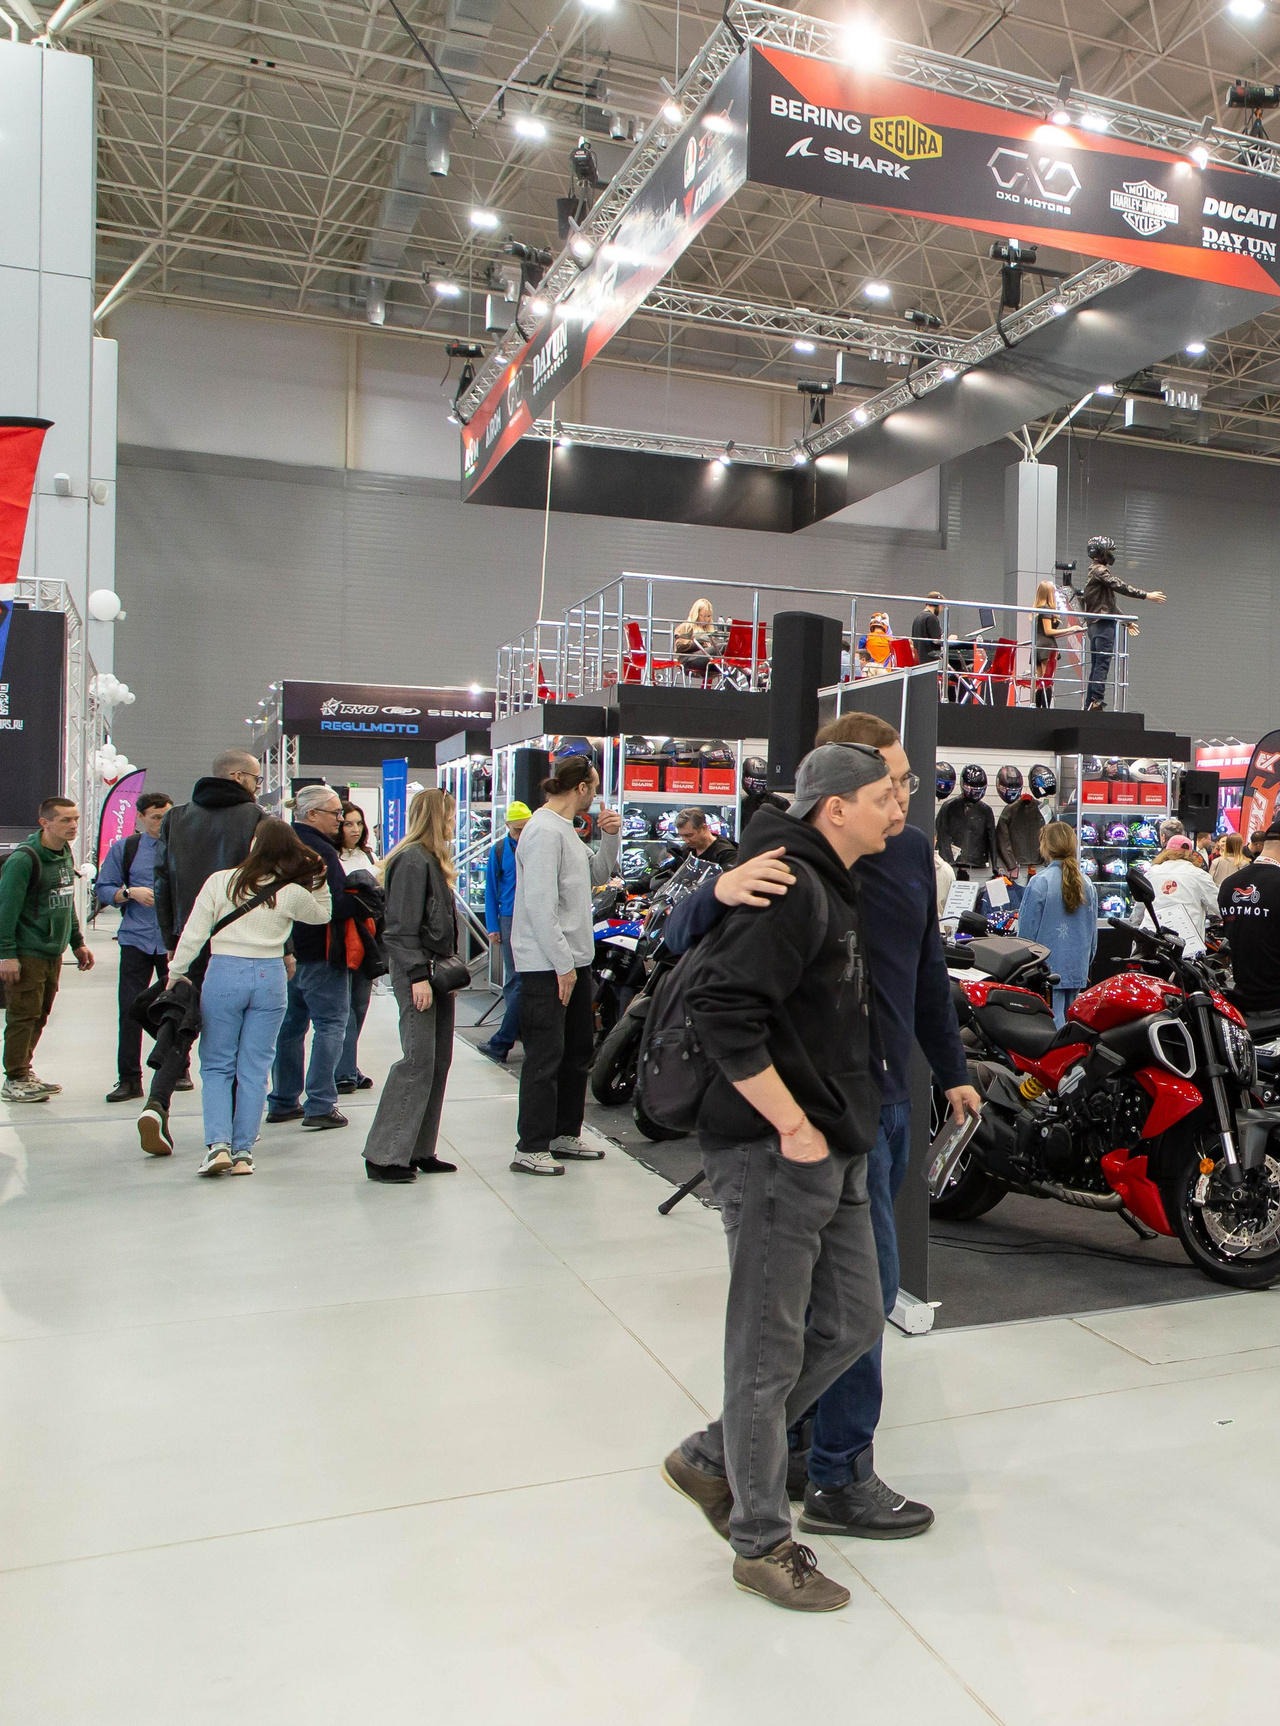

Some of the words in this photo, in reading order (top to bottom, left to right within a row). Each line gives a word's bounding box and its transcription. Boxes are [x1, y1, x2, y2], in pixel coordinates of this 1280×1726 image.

[770, 95, 862, 135] BERING
[873, 119, 938, 157] SEGURA
[824, 147, 911, 181] SHARK
[996, 190, 1020, 204] OXO
[1024, 197, 1072, 216] MOTORS
[1128, 185, 1162, 202] MOTOR
[1127, 212, 1162, 233] CYCLES
[1203, 197, 1278, 230] DUCATI
[1202, 227, 1277, 257] DAYUN
[1202, 242, 1277, 263] MOTORCYCLE
[533, 318, 568, 385] DAYUN
[321, 720, 419, 734] REGULMOTO
[427, 709, 493, 719] SENKE
[1220, 906, 1270, 917] HOTMOT
